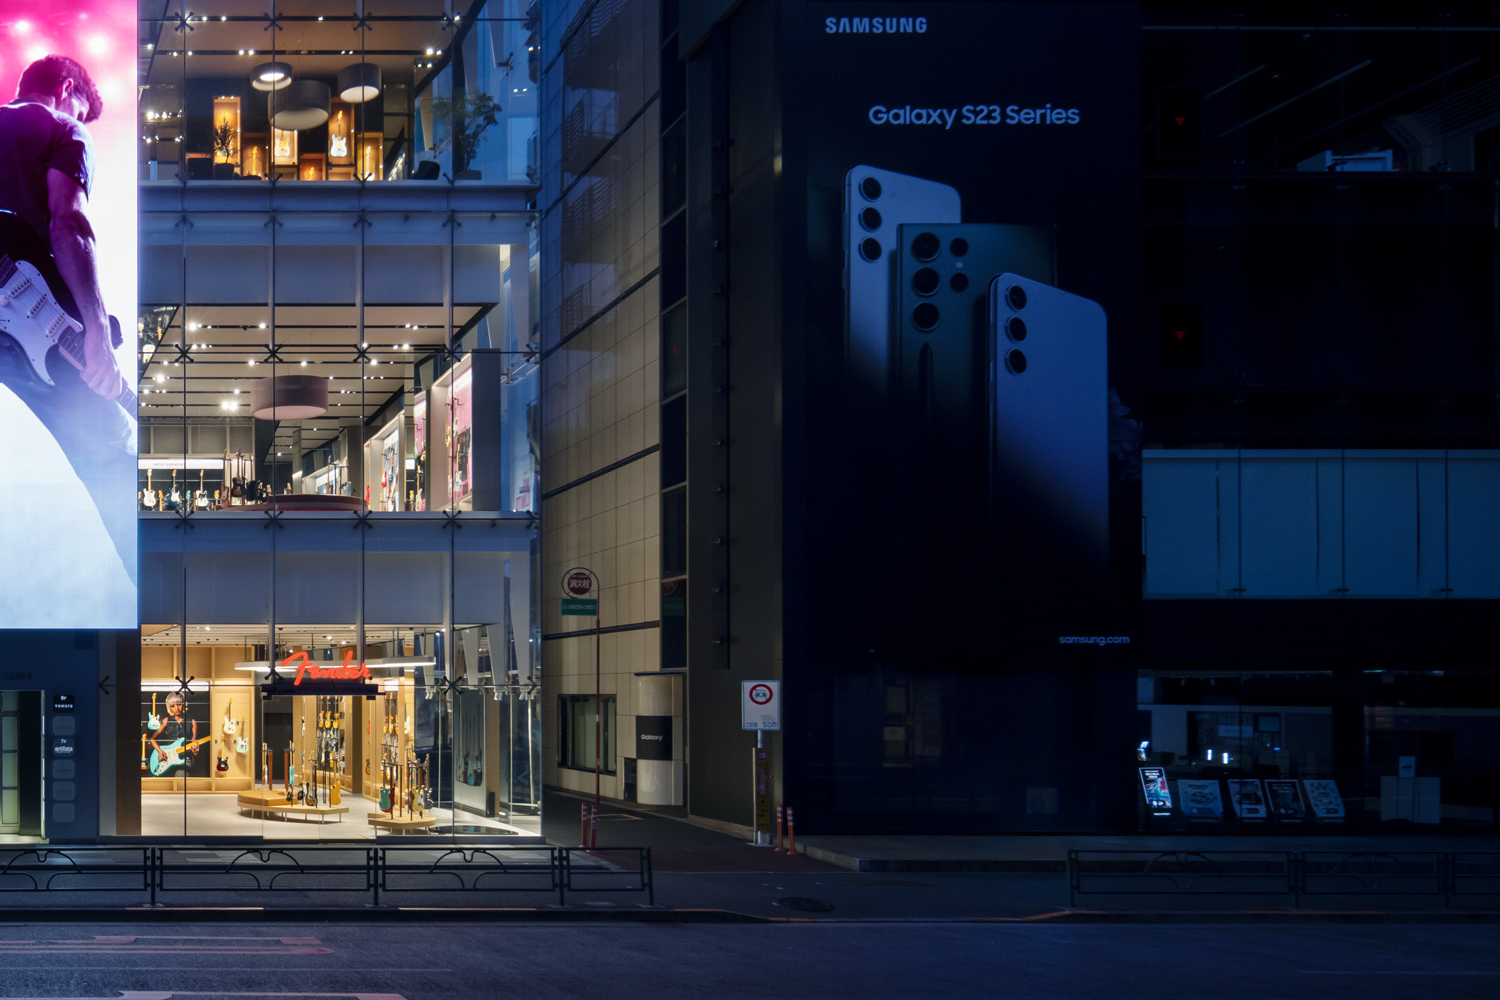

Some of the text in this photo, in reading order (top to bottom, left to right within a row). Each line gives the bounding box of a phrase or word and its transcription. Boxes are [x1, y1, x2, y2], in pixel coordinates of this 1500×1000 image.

[825, 16, 927, 34] SAMSUNG
[868, 103, 1080, 130] Galaxy S23 Series
[1059, 636, 1131, 646] samsung.com
[280, 650, 372, 686] Fender
[640, 733, 663, 742] Galaxy
